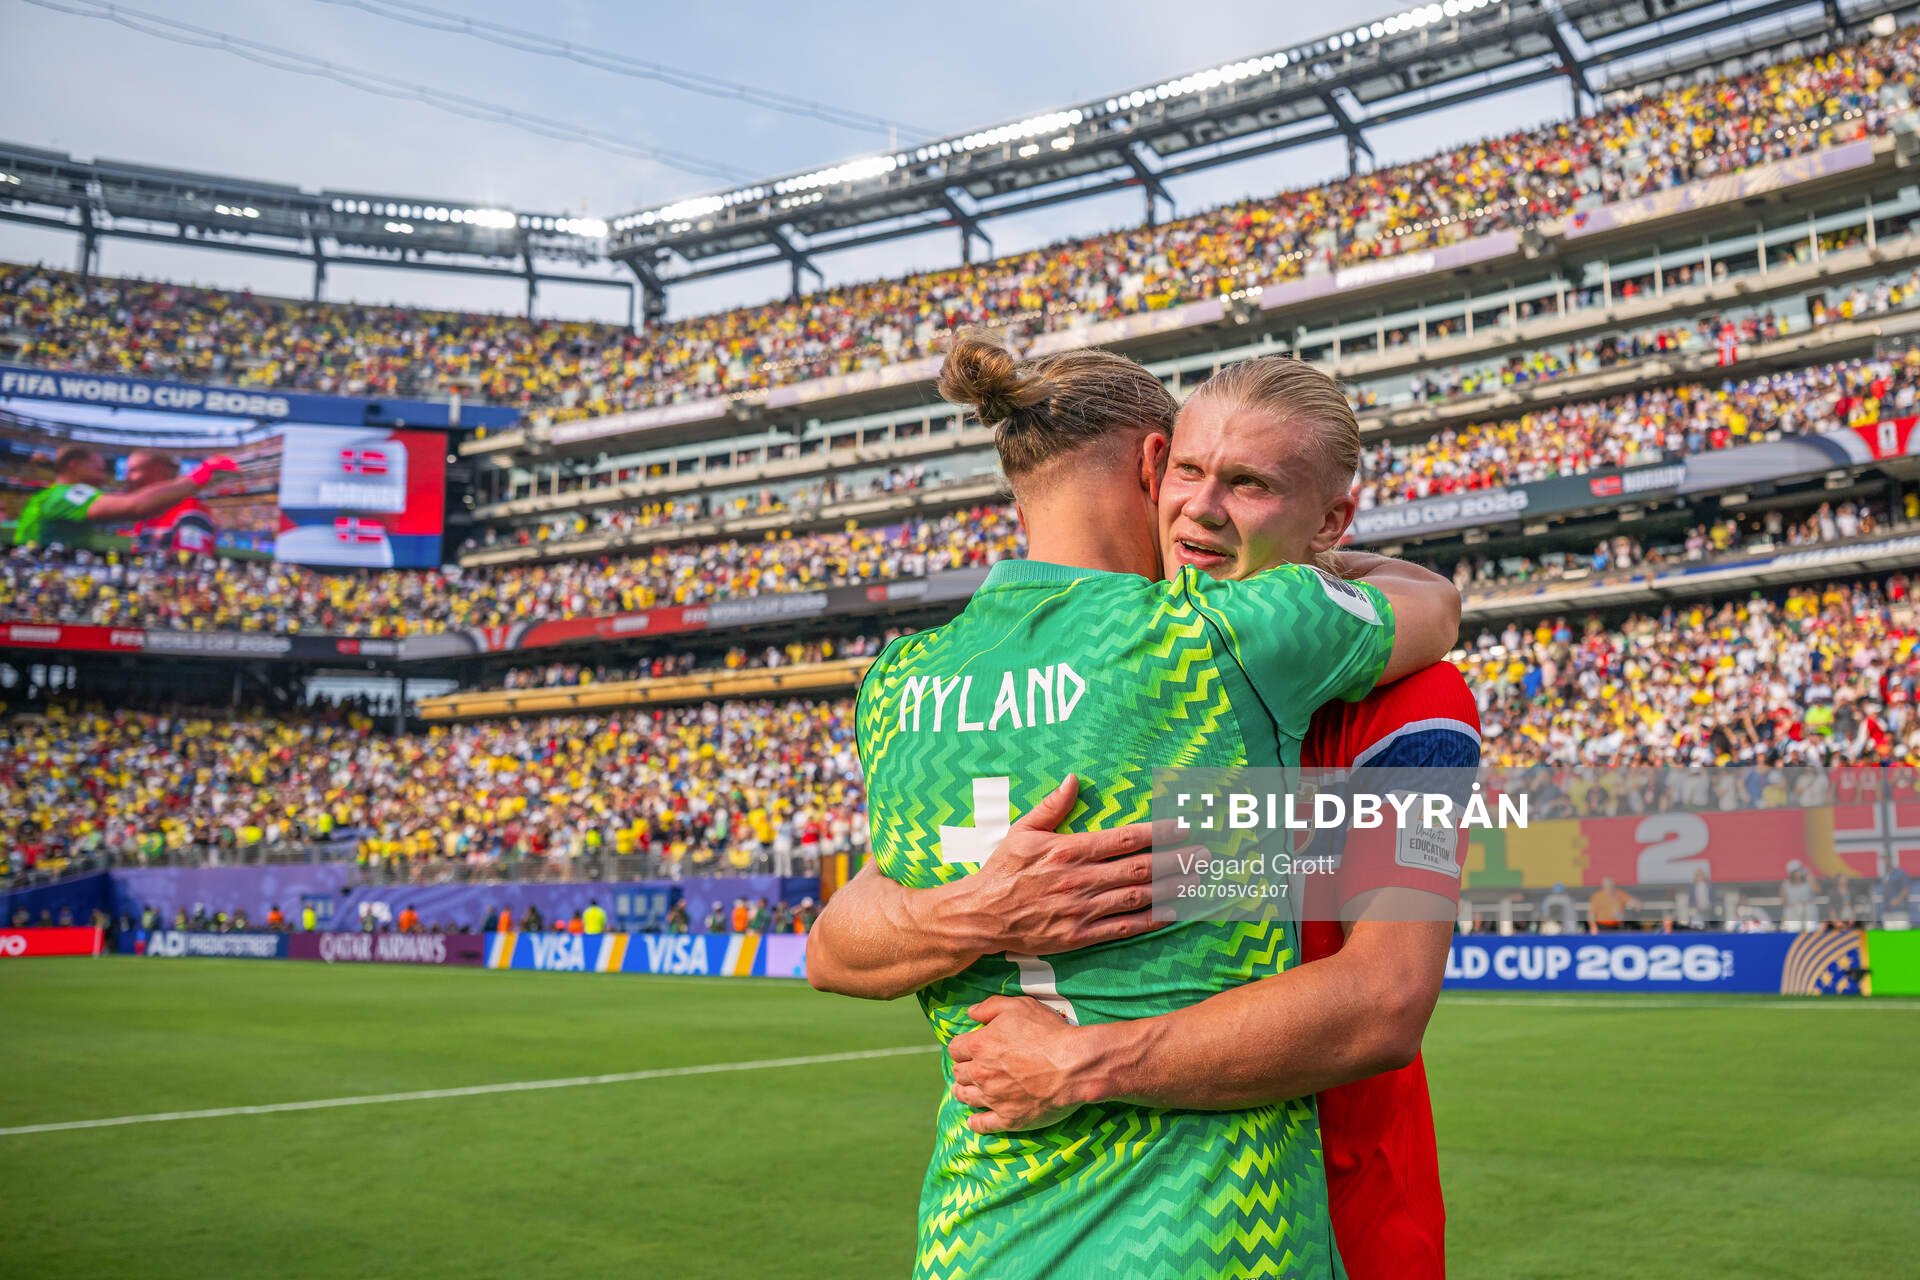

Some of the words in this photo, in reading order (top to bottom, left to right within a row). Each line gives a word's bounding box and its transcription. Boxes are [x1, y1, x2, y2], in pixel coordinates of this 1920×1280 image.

[2, 373, 57, 396] FIFA
[60, 377, 150, 404] WORLD
[153, 387, 203, 409] CUP
[204, 392, 290, 418] 2026
[1356, 507, 1421, 532] WORLD
[1422, 502, 1459, 524] CUP
[1460, 491, 1529, 515] 2026
[900, 662, 1086, 732] NYLAND
[1409, 838, 1451, 861] EDUCATION
[1415, 823, 1437, 839] Unite
[1469, 821, 1523, 888] 1
[1635, 812, 1710, 884] 2
[1423, 854, 1440, 865] FIFA
[319, 932, 372, 964] QATAR
[376, 933, 447, 964] AIRWAYS
[530, 935, 585, 971] VISA
[645, 935, 709, 975] VISA
[1494, 946, 1572, 981] CUP
[1575, 944, 1722, 982] 2026
